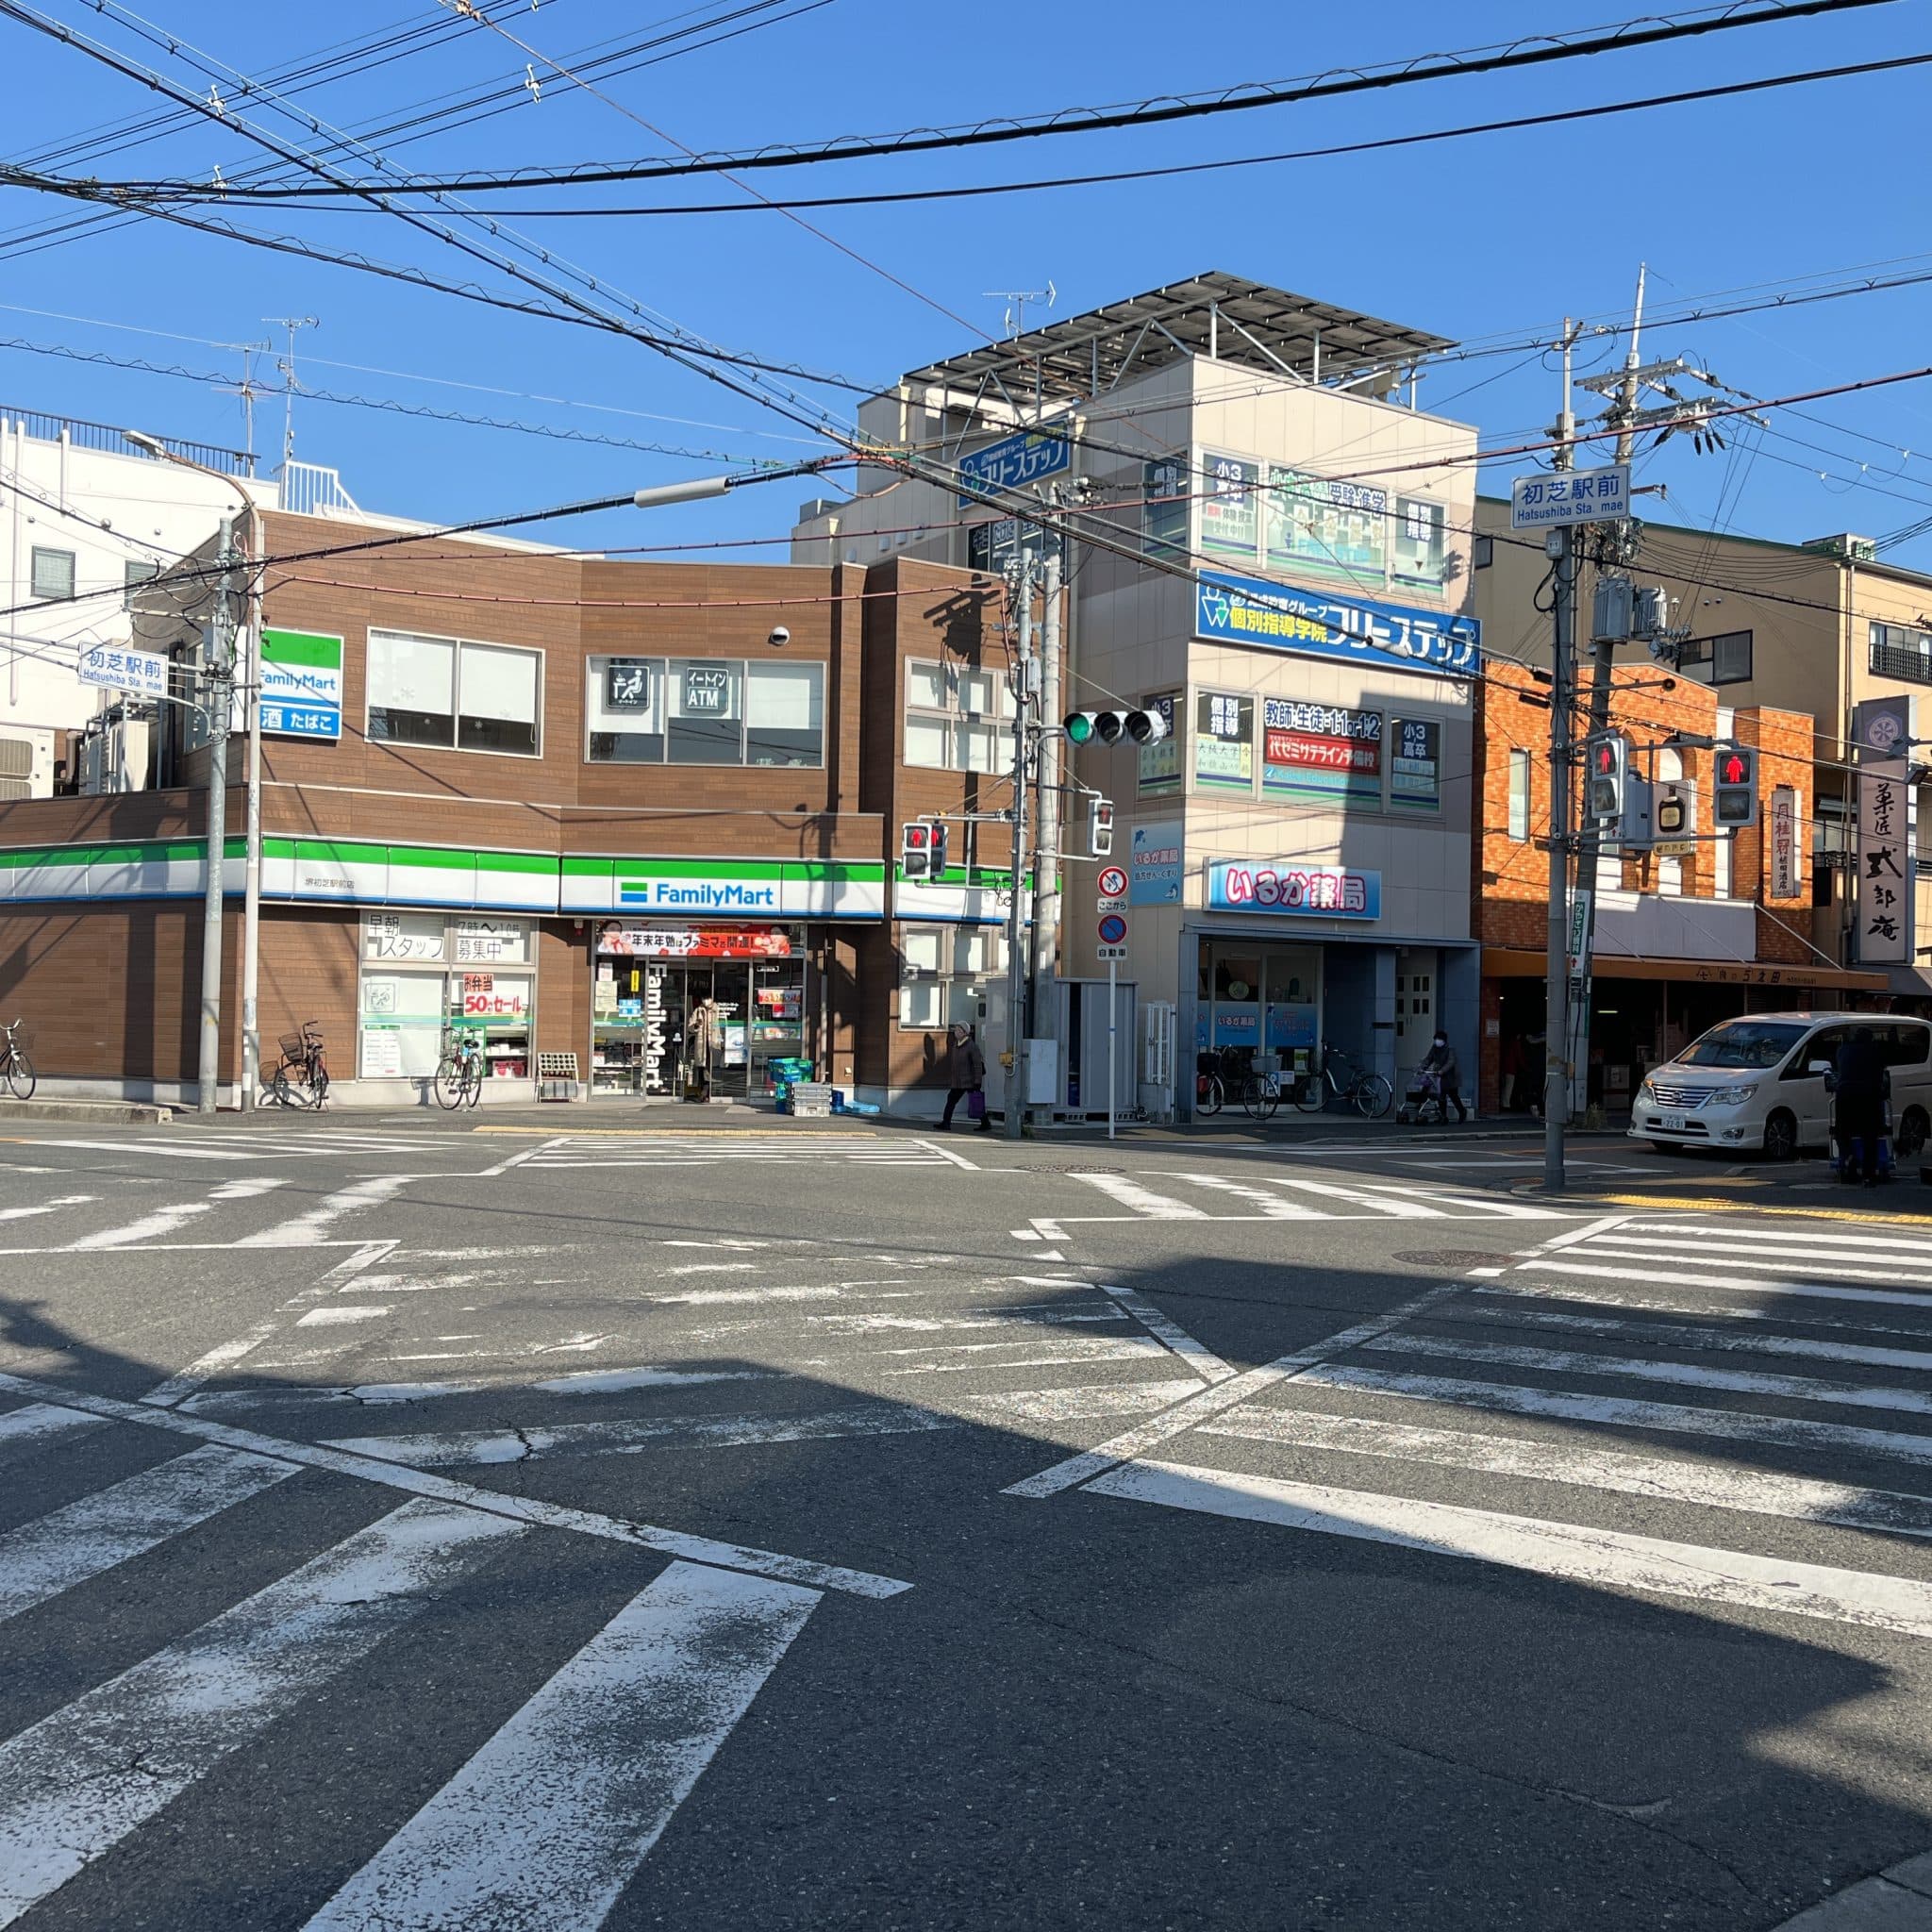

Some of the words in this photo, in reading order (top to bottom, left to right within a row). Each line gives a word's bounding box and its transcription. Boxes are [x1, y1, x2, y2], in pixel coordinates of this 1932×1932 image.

[1522, 475, 1620, 505] 初芝駅前
[1517, 506, 1571, 521] Hatsushiba
[1576, 503, 1594, 515] Sta.
[1601, 501, 1623, 511] mae
[1229, 608, 1327, 643] 個別指導学院
[1327, 605, 1474, 664] フリーステップ
[88, 649, 161, 678] 初芝駅前
[84, 669, 125, 685] Hatsushiba
[146, 681, 162, 691] mae
[689, 672, 726, 687] イートイン
[688, 690, 718, 707] ATM
[1211, 696, 1239, 717] 個別
[261, 708, 283, 728] 酒
[291, 712, 332, 731] たばこ
[1210, 717, 1239, 736] 指導
[1404, 724, 1425, 740] 小3
[1404, 741, 1425, 758] 高卒
[1873, 783, 1894, 836] 菓匠
[1775, 803, 1790, 855] 月桂冠
[1133, 848, 1178, 865] いるか薬局
[657, 883, 773, 907] FamilyMart
[1226, 869, 1366, 911] いるか薬局
[1099, 902, 1126, 910] ここから
[370, 914, 399, 937] 早朝
[382, 936, 443, 958] スタッフ
[458, 939, 502, 959] 募集中
[1099, 948, 1125, 957] 自動車
[464, 974, 493, 991] お弁当
[647, 963, 668, 1089] FamilyMart
